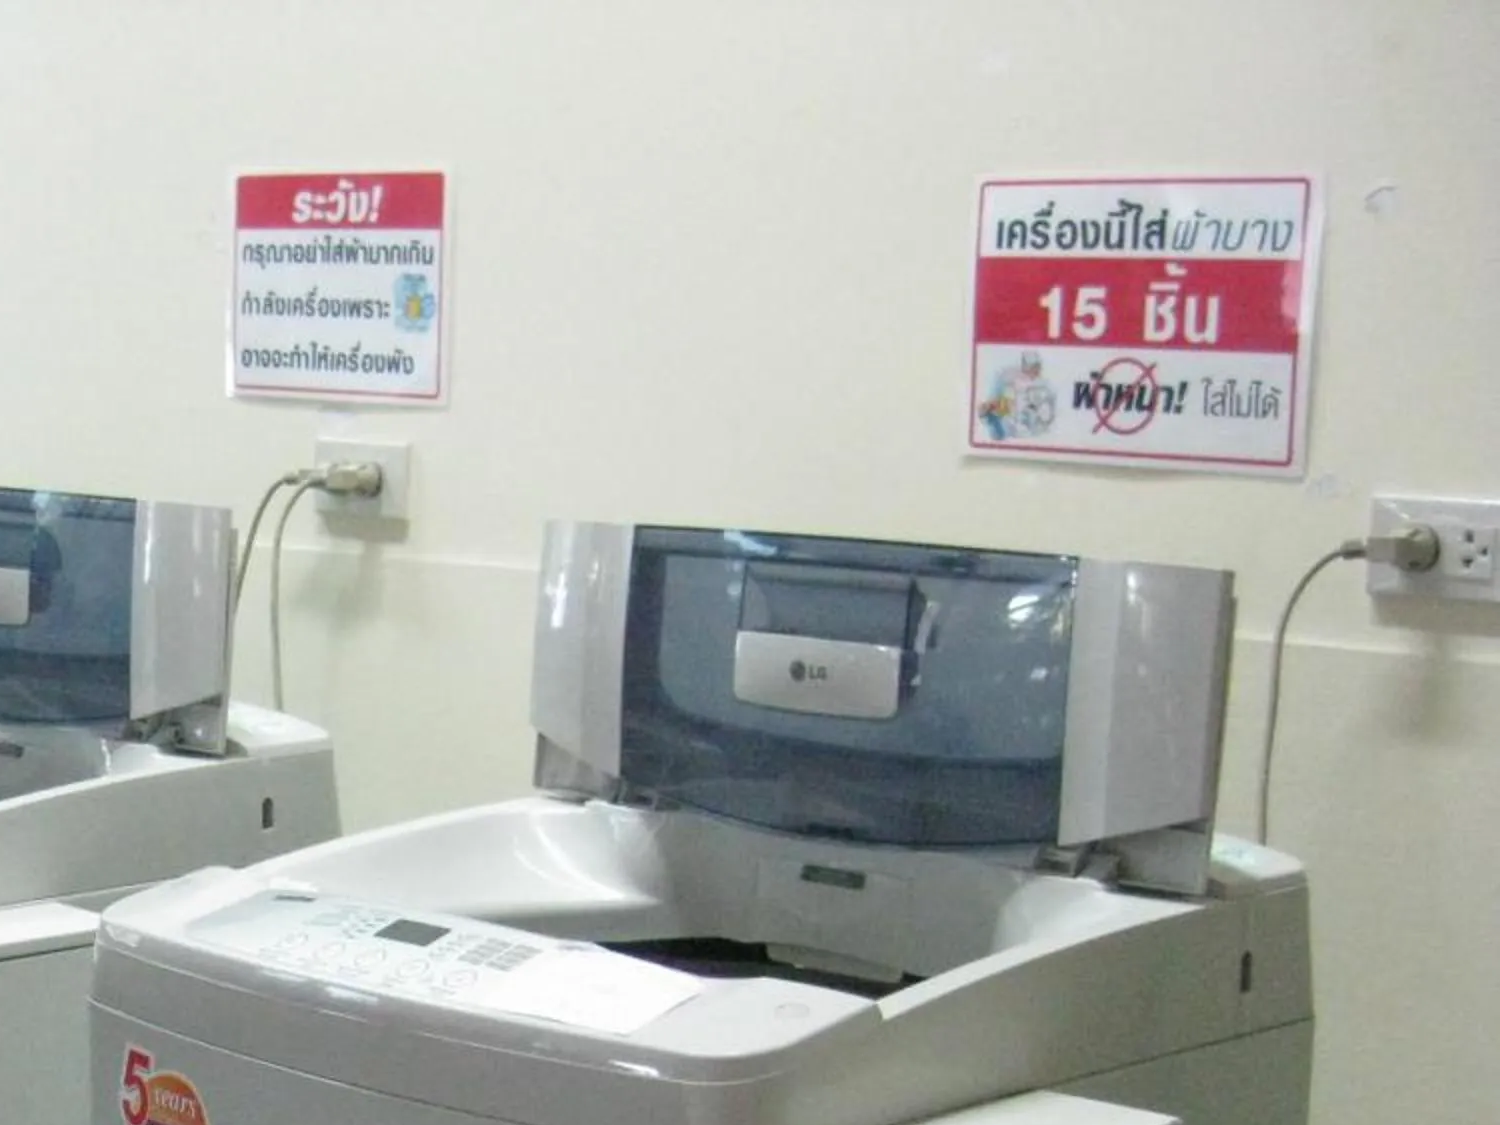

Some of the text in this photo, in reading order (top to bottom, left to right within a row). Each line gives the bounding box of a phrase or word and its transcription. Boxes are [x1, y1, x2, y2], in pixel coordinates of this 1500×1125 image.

[292, 178, 384, 224] ระวัง!
[1039, 262, 1220, 344] 15 ชิ้น
[1072, 371, 1284, 420] ผ้าหนา! ใส่ไม่ได้
[808, 665, 828, 681] LG
[122, 1049, 151, 1125] 5
